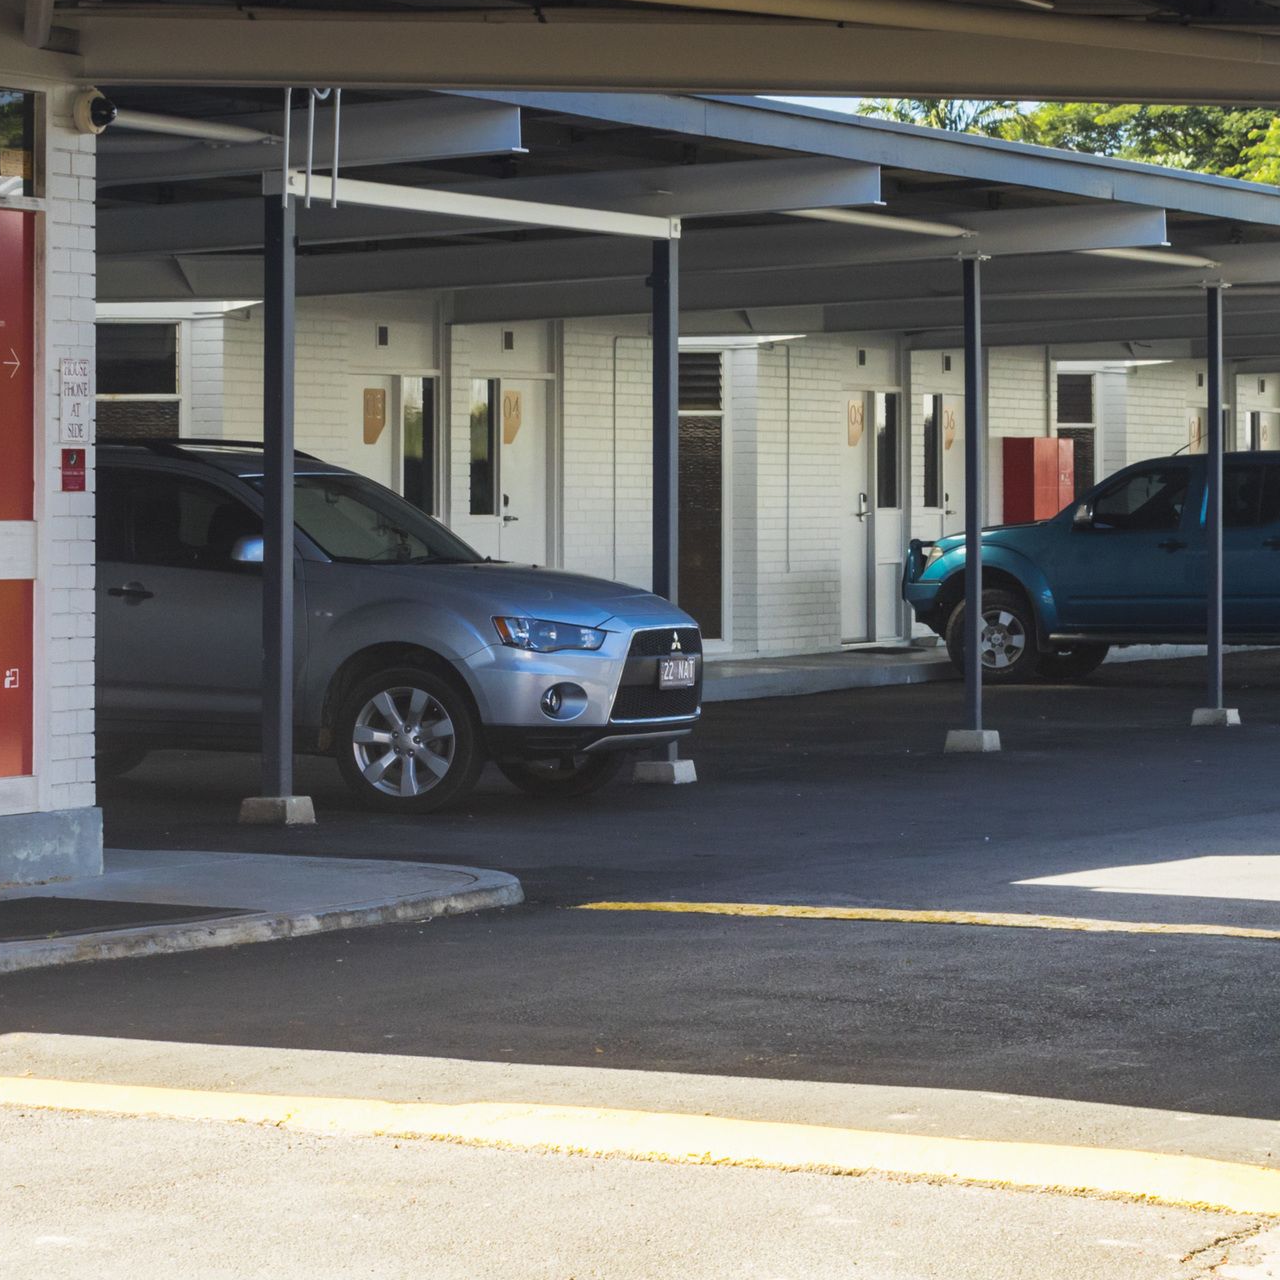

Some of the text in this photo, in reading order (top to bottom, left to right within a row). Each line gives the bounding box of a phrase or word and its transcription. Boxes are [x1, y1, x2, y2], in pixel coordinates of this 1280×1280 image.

[64, 360, 88, 376] HOUSE
[64, 381, 88, 397] PHONE
[71, 403, 81, 418] AT
[67, 423, 83, 438] SIDE
[664, 660, 695, 680] 22 NAT
